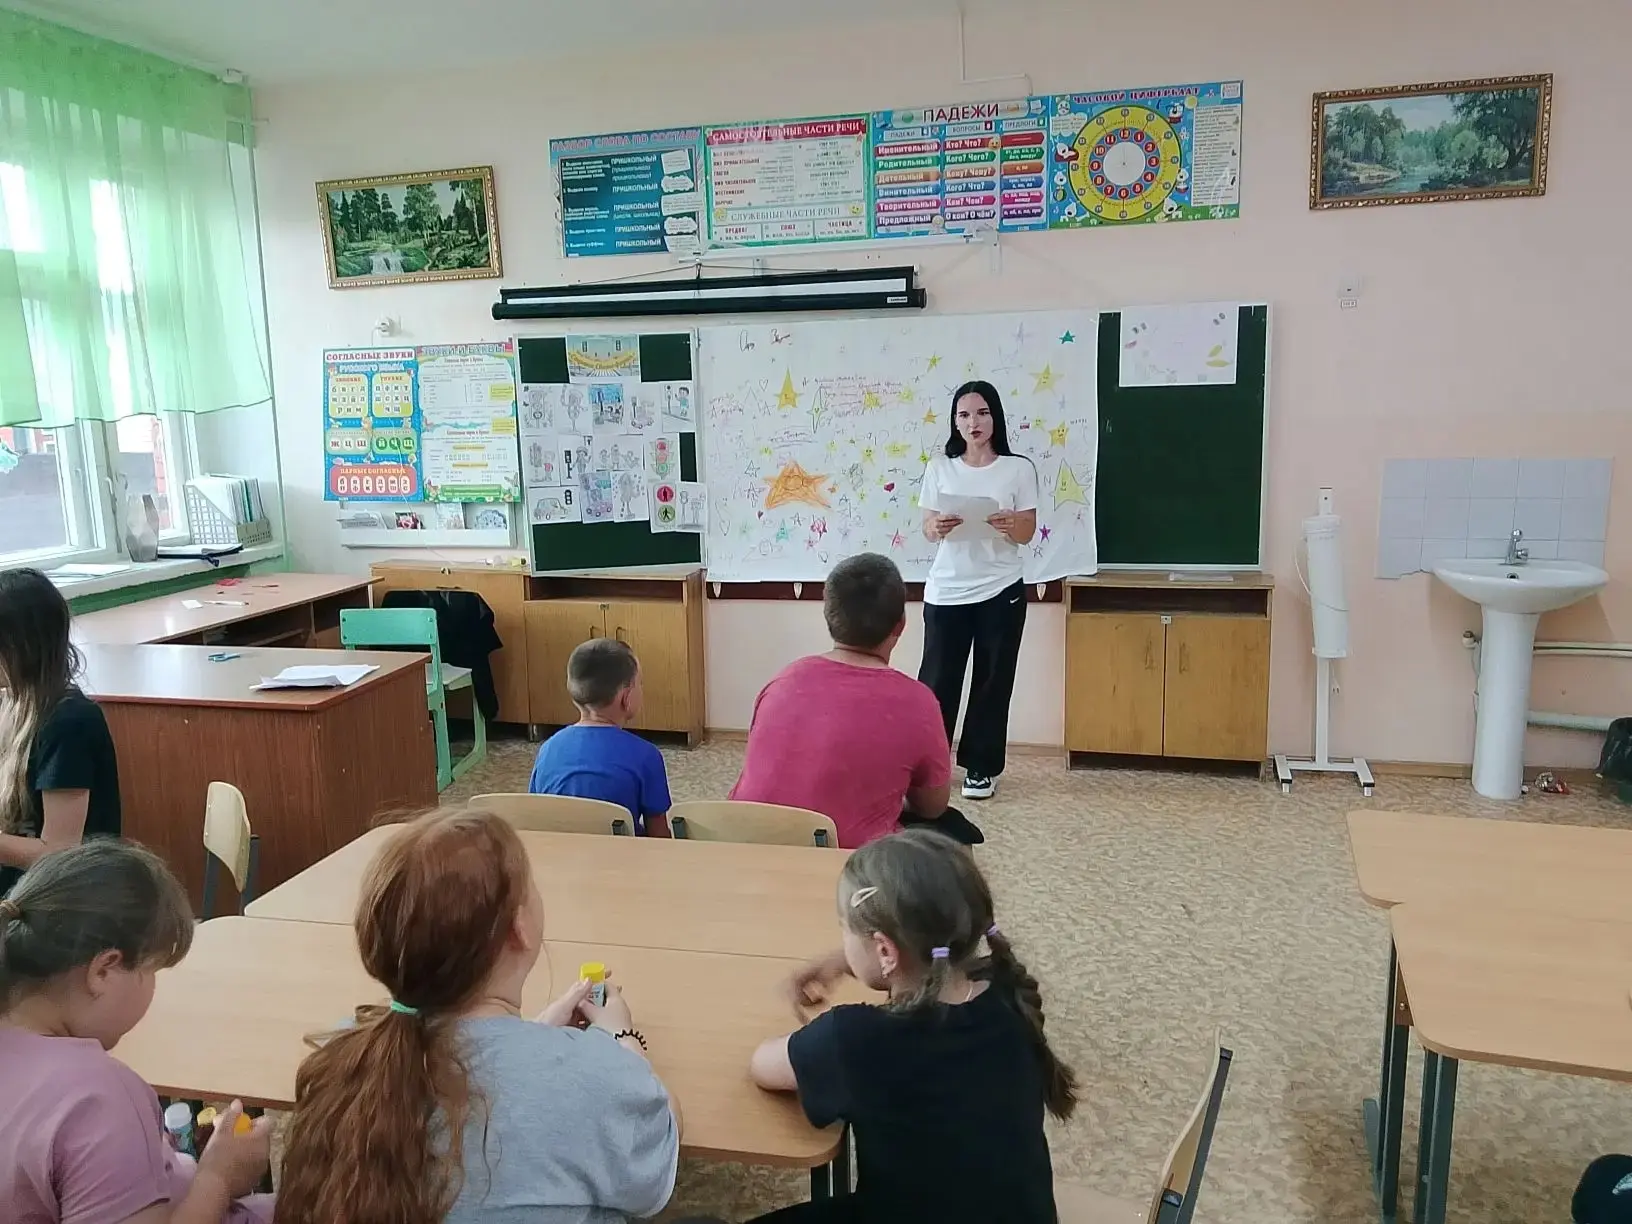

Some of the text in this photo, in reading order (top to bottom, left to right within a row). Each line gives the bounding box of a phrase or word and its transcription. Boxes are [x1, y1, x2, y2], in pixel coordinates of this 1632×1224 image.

[923, 103, 1000, 123] ПАДЕЖИ
[804, 124, 835, 135] ЧАСТИ
[836, 121, 860, 133] РЕЧИ
[952, 125, 981, 133] ВОПРОСЫ
[1005, 121, 1037, 129] ПРЕДЛОГИ
[890, 130, 915, 138] ПАДЕЖИ
[878, 143, 938, 154] Именительный
[946, 139, 981, 149] Кто? Что?
[946, 153, 989, 163] Кого? Чего?
[878, 158, 933, 169] Родительный
[878, 173, 924, 184] Дательный
[946, 168, 991, 179] Кому? Чему?
[613, 184, 658, 193] ПРИШКОЛЬНЫЙ
[879, 186, 933, 197] Винительный
[946, 182, 985, 192] Кого? Что?
[946, 196, 983, 206] Кем? Чем?
[614, 202, 659, 212] ПРИШКОЛЬНЫЙ
[879, 201, 937, 212] Творительный
[731, 206, 840, 222] СЛУЖЕБНЫЕ ЧАСТИ РЕЧИ
[952, 211, 968, 219] ком?
[879, 216, 931, 227] Предложный
[615, 224, 660, 233] ПРИШКОЛЬНЫЙ
[616, 239, 661, 248] ПРИШКОЛЬНЫЙ
[326, 351, 413, 361] СОГЛАСНЫЕ ЗВУКИ
